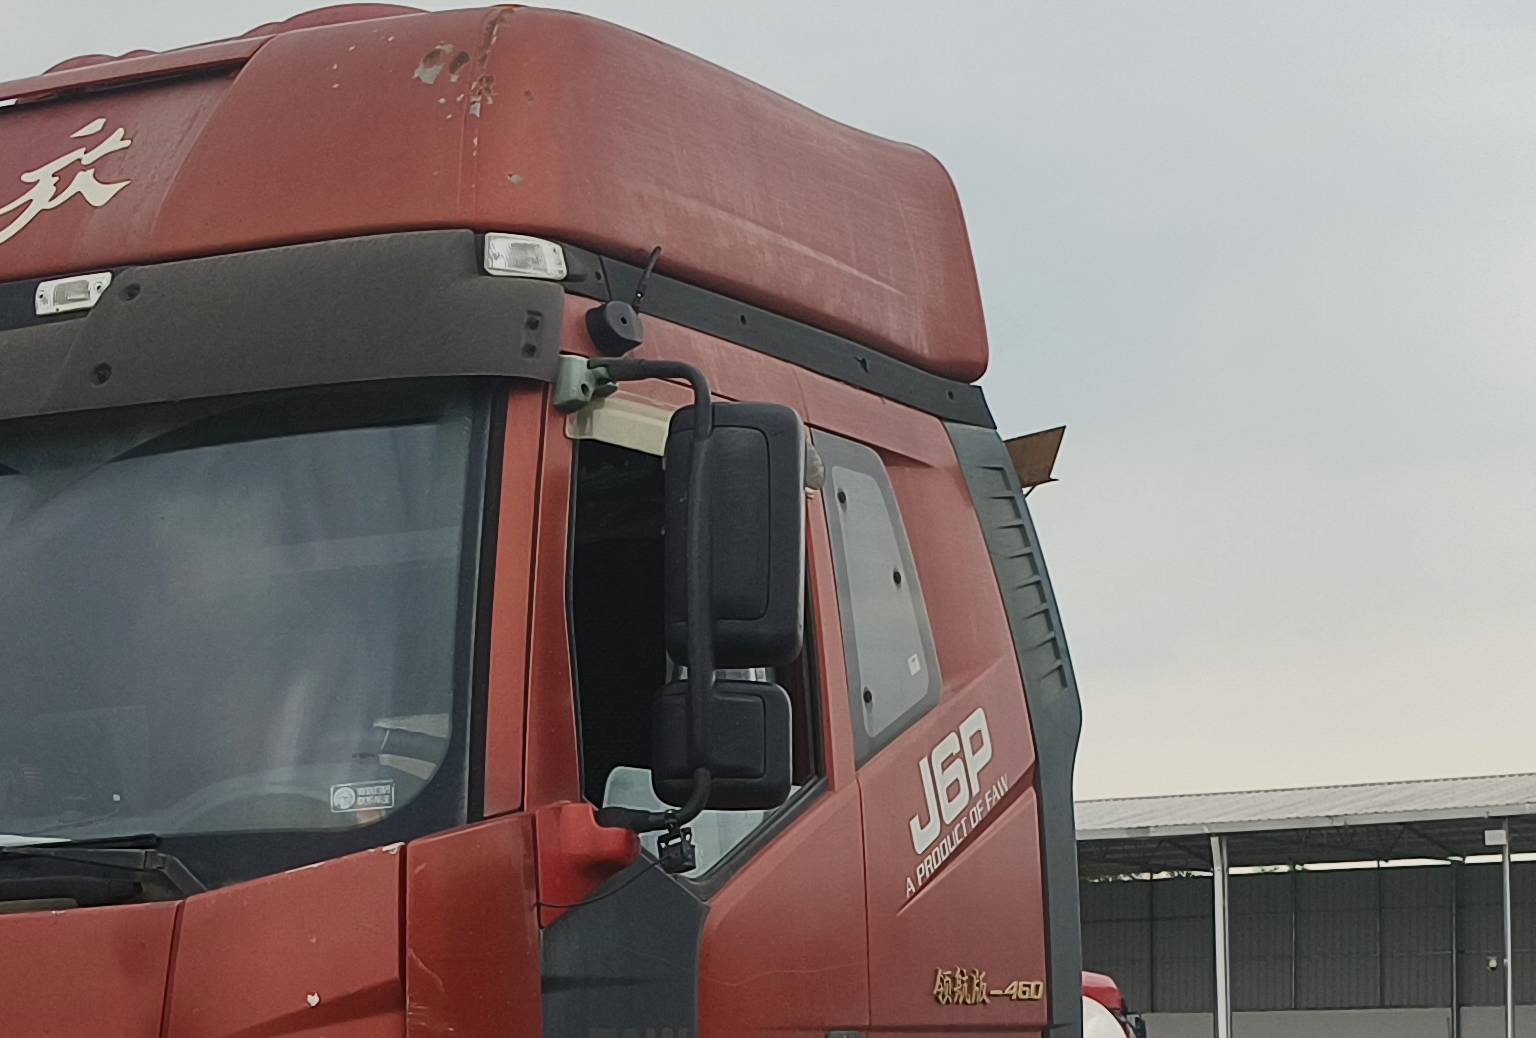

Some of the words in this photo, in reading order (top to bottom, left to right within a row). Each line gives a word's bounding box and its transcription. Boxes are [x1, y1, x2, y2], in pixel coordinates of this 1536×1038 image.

[906, 877, 915, 898] A
[916, 816, 967, 886] PRODUCT
[969, 799, 984, 829] OF
[985, 773, 1009, 812] FAW
[910, 707, 992, 855] J6P
